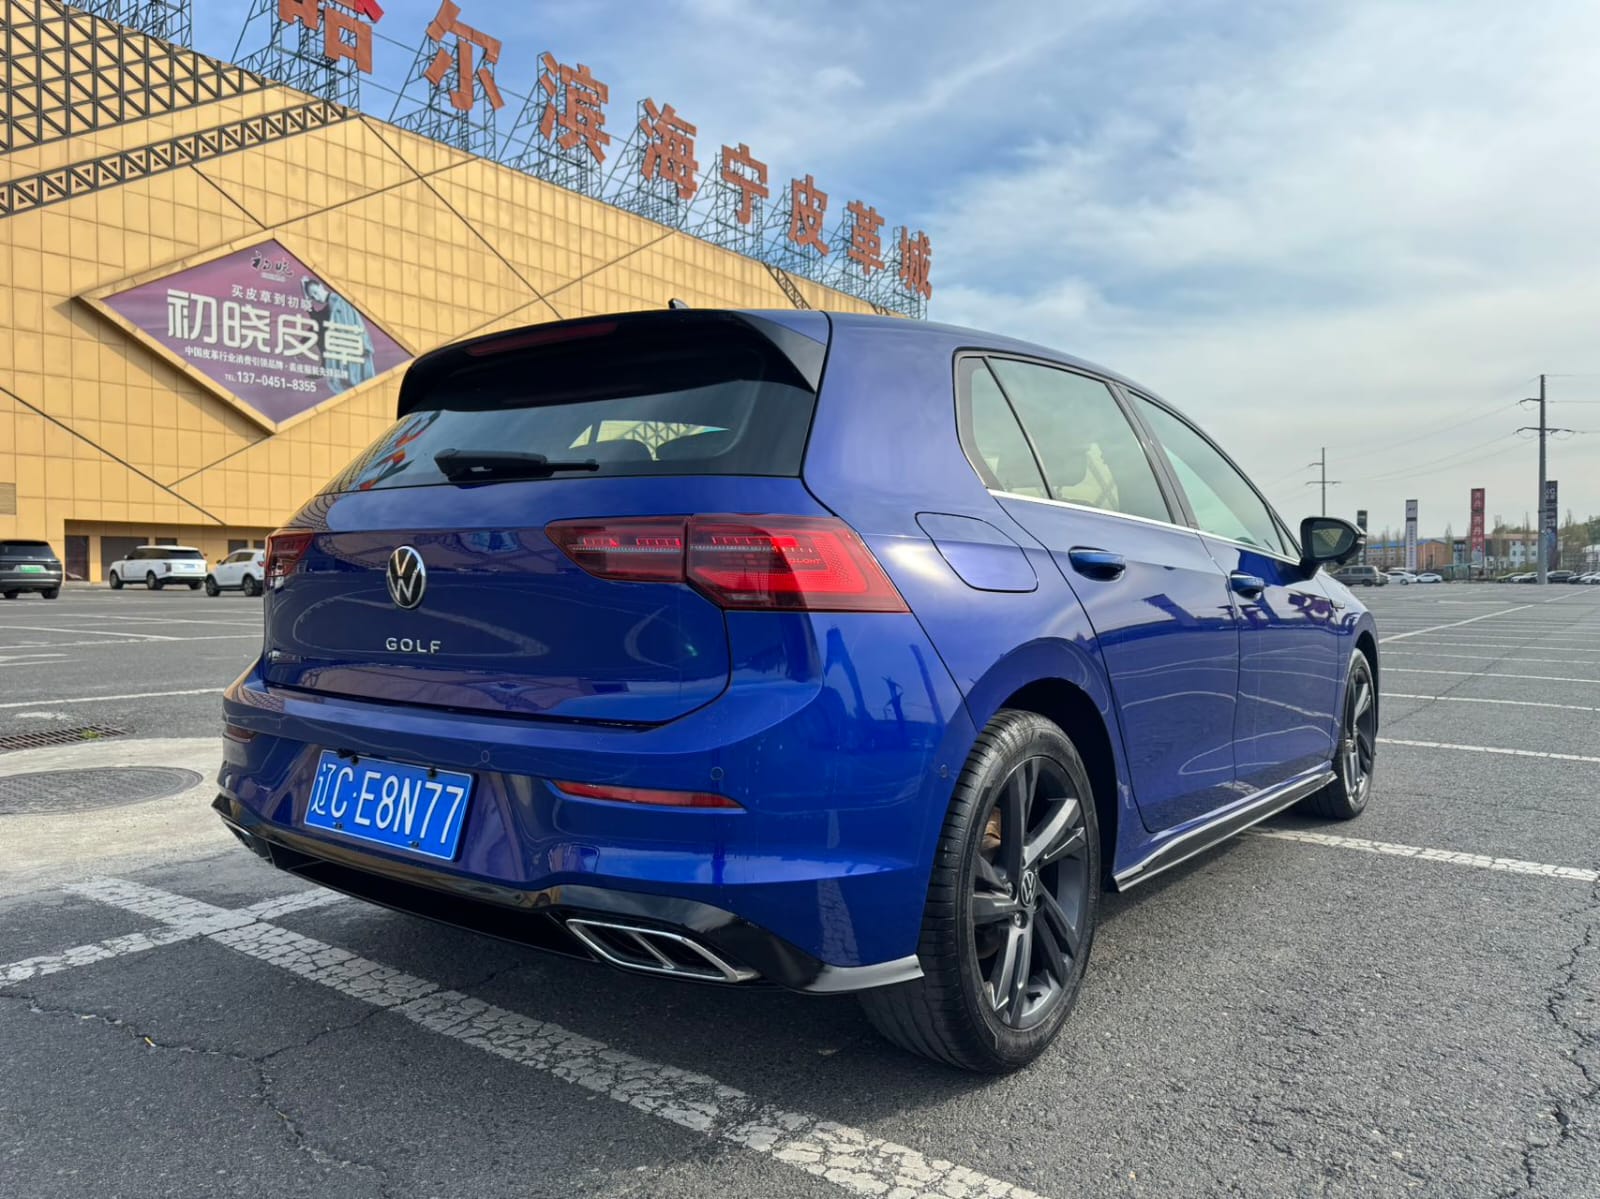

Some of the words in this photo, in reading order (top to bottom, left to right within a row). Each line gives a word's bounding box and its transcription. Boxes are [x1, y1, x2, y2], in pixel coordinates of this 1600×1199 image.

[167, 288, 366, 366] 初晓皮草
[237, 371, 317, 393] 137-0451-8355
[385, 636, 442, 655] GOLF
